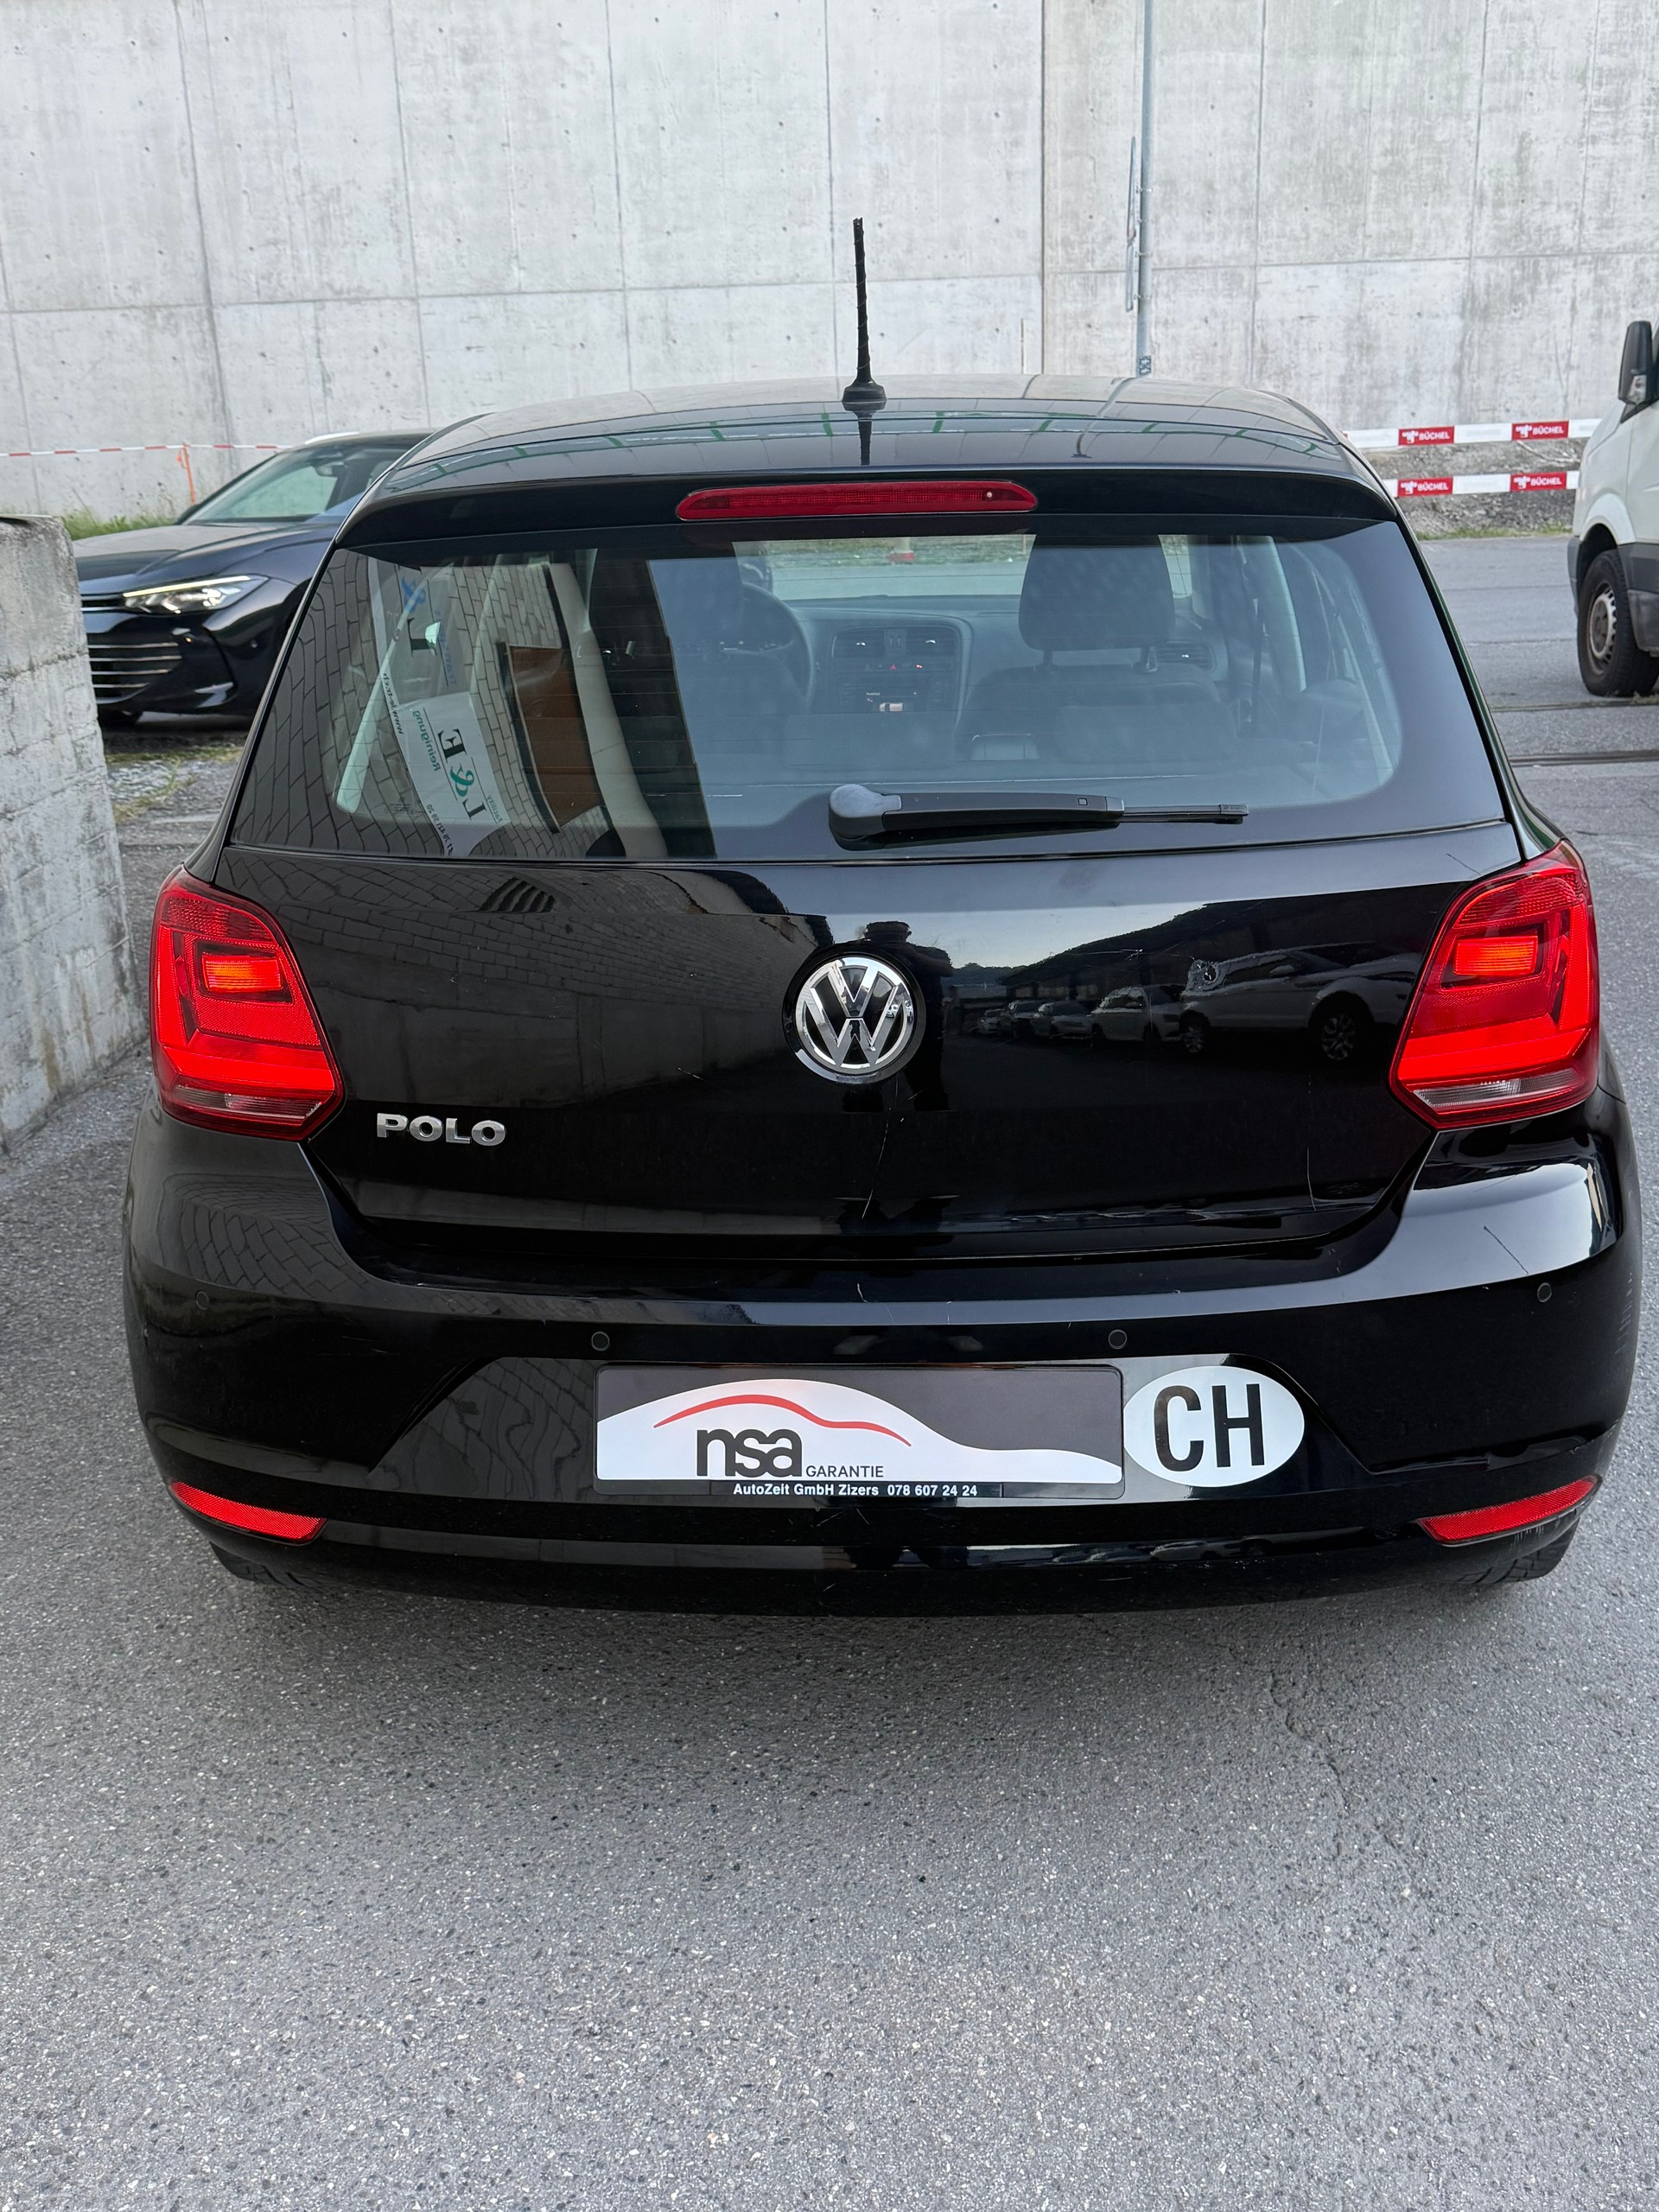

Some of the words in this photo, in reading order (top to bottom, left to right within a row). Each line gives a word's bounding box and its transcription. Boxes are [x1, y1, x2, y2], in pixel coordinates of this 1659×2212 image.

[377, 1112, 506, 1147] POLO
[1154, 1383, 1265, 1472] CH
[696, 1428, 803, 1478] nsa
[805, 1465, 885, 1478] GARANTIE
[733, 1483, 790, 1497] AutoZeit
[793, 1484, 835, 1497] GmbH
[838, 1484, 880, 1497] Zizers
[887, 1484, 911, 1497] 078
[914, 1484, 938, 1497] 607
[942, 1484, 958, 1497] 24
[962, 1484, 978, 1497] 24
